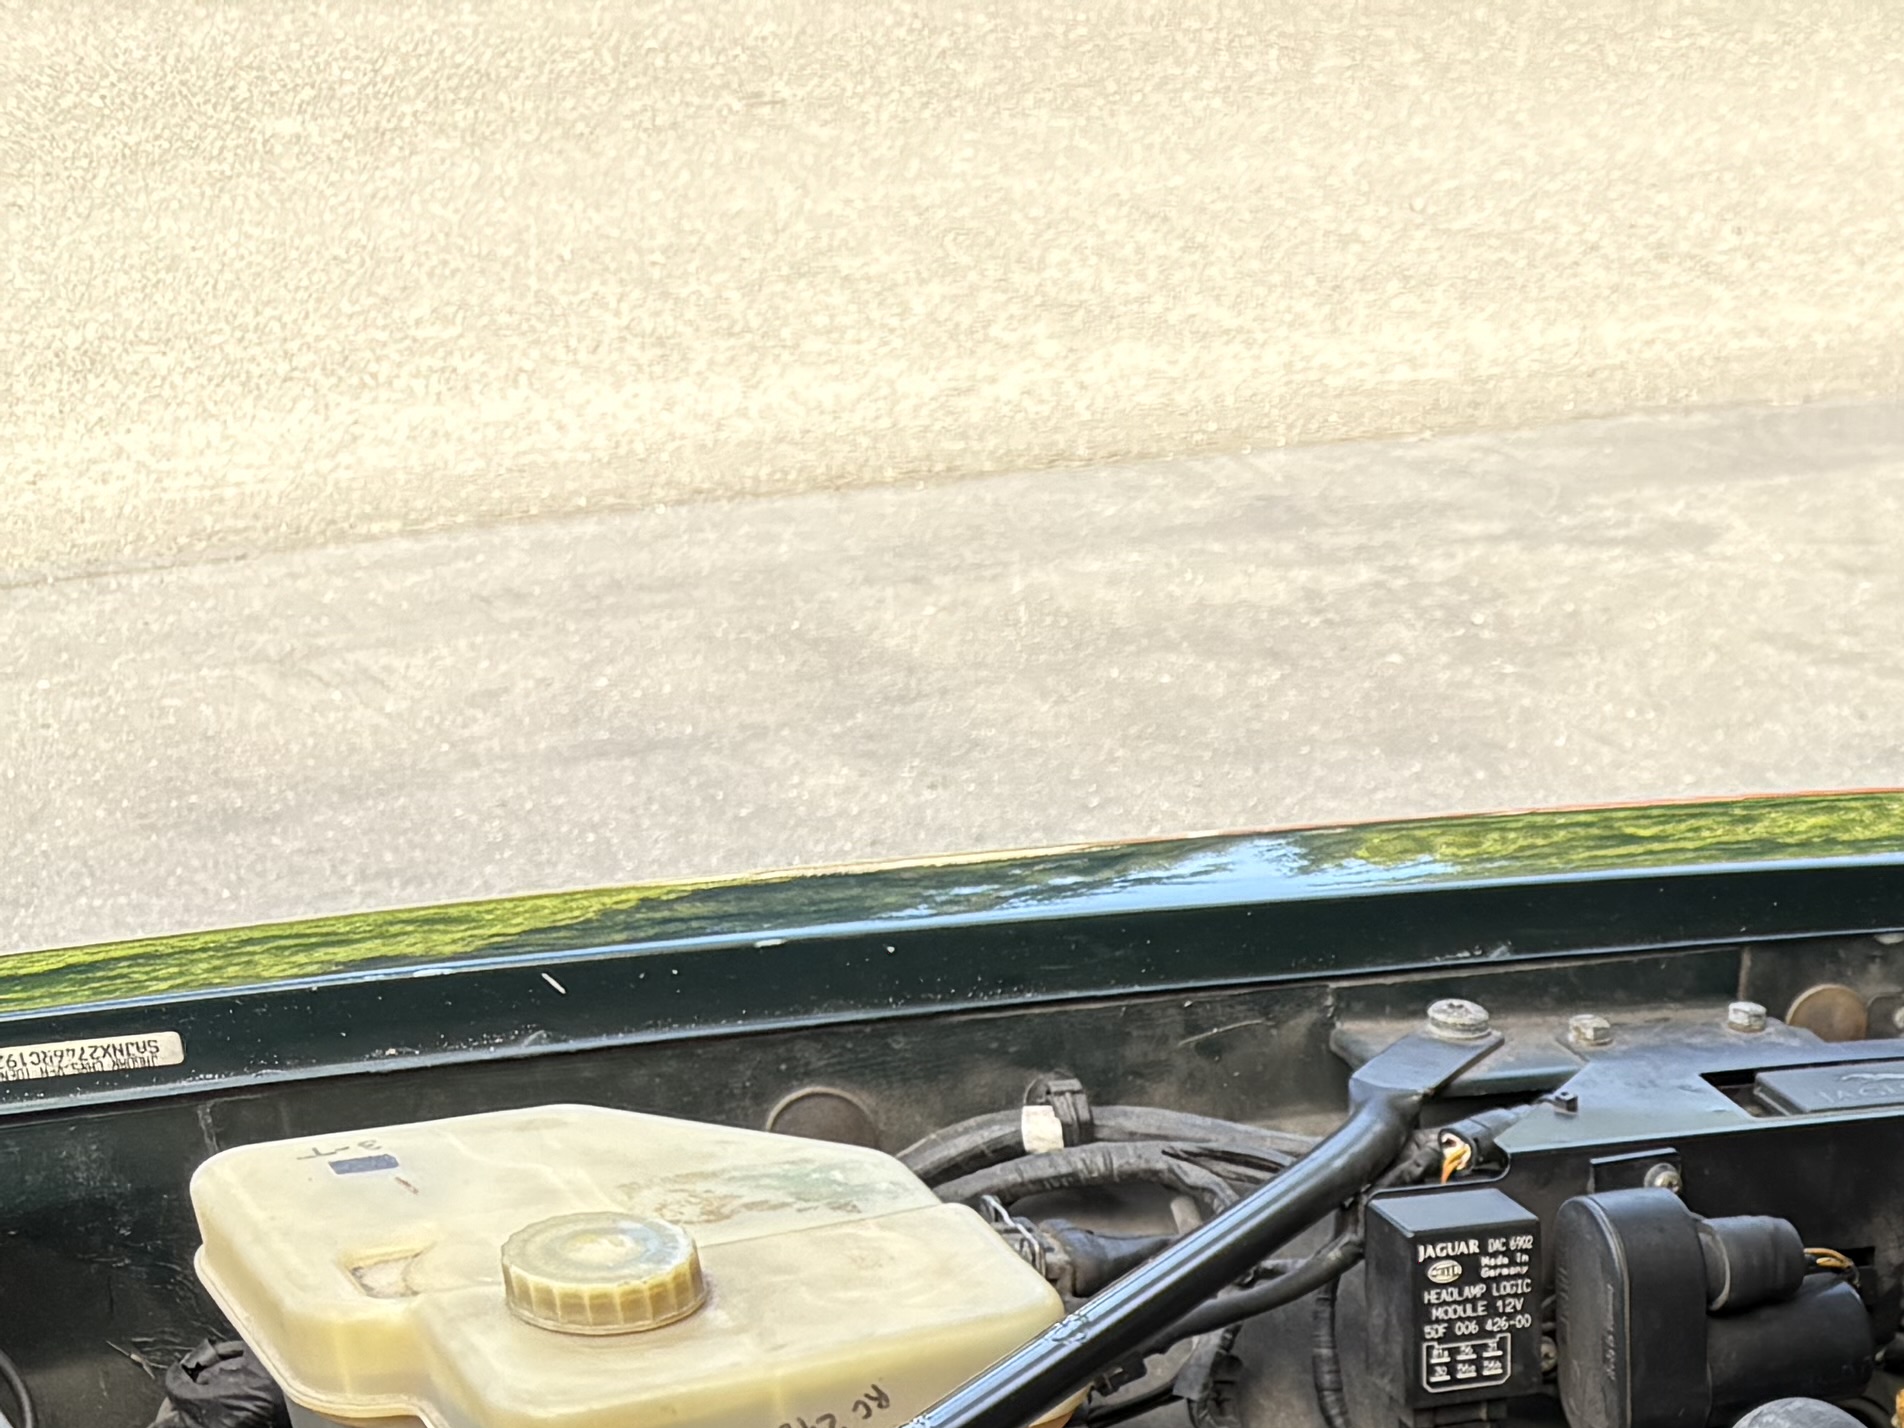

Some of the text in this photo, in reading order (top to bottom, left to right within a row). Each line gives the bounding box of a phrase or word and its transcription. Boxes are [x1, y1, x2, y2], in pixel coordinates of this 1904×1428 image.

[1417, 1239, 1480, 1263] JAGUAR
[1488, 1238, 1506, 1252] DAC
[1481, 1255, 1509, 1266] Made
[1481, 1266, 1529, 1279] Germany
[1424, 1279, 1532, 1304] HEADLAMP LOGIC
[1431, 1297, 1524, 1320] MODULE 12V
[1424, 1314, 1532, 1339] 5DF 006 426-00
